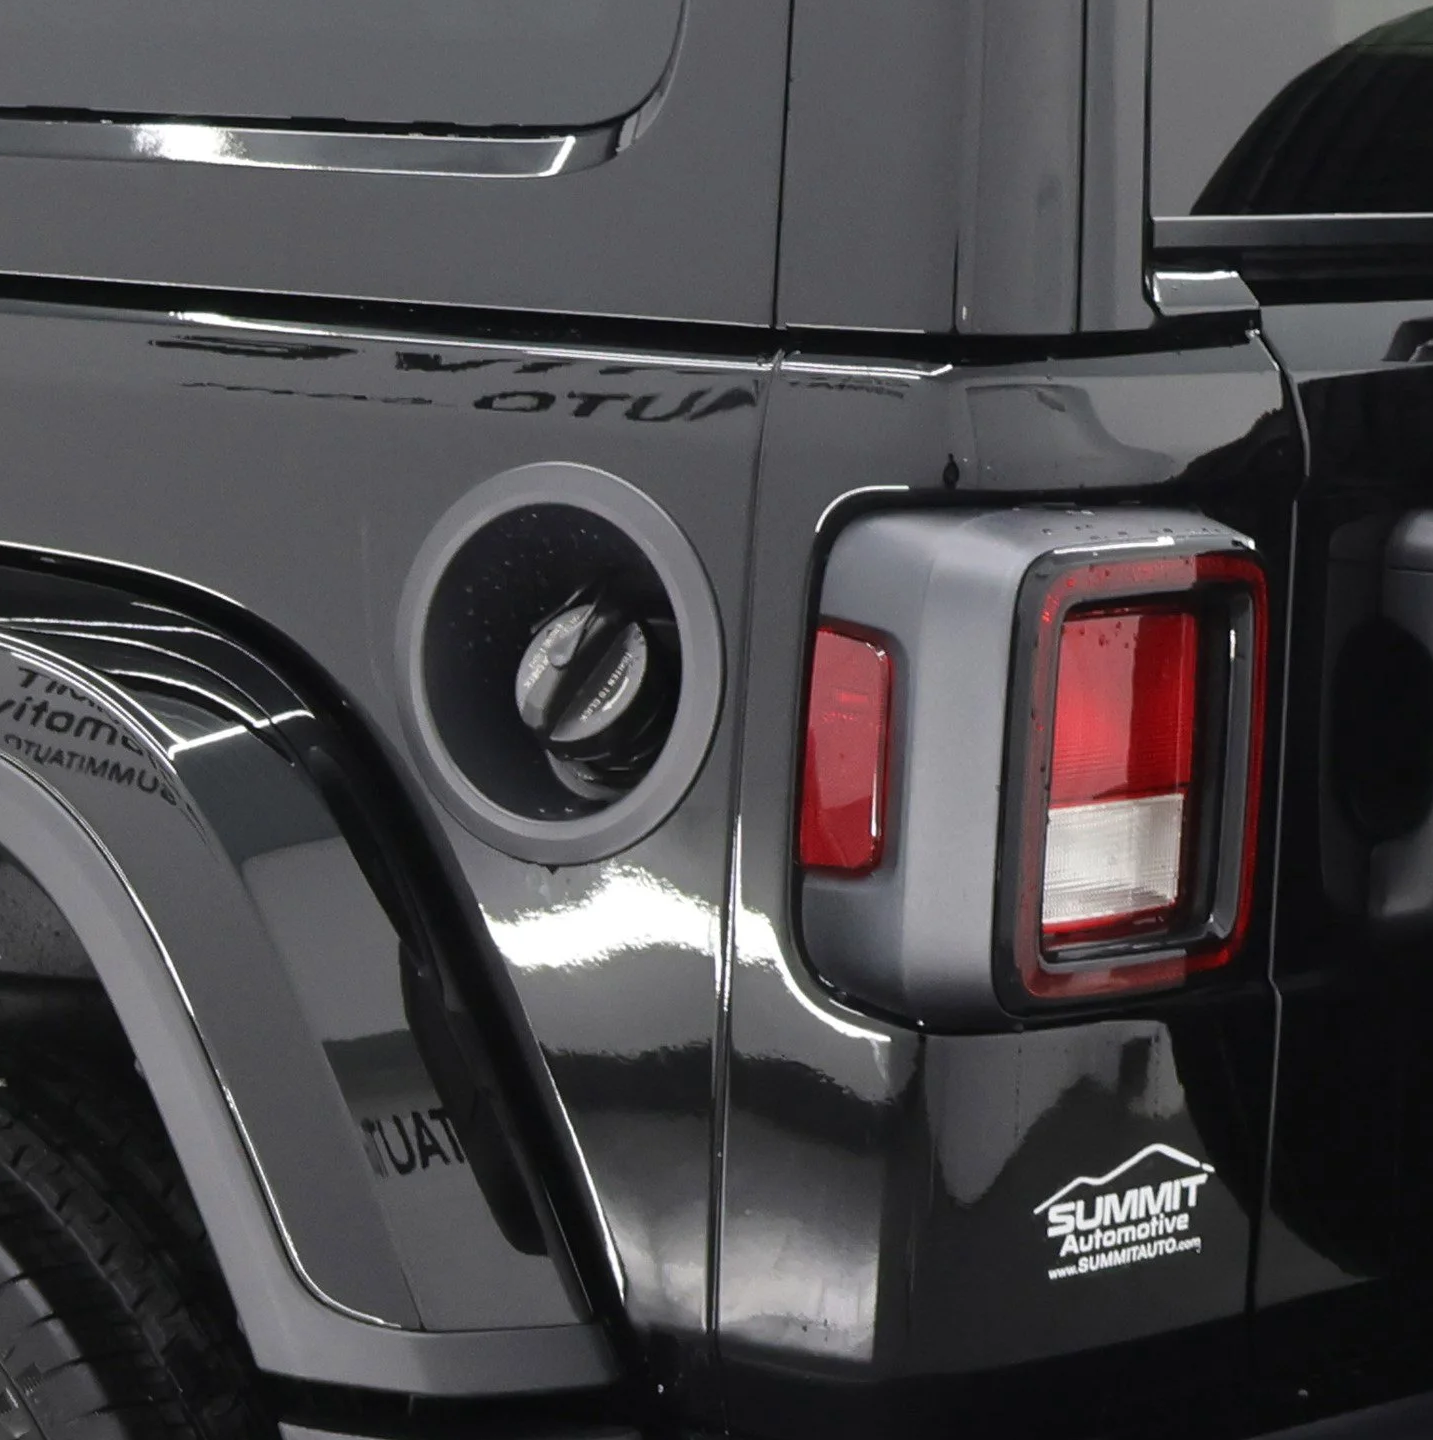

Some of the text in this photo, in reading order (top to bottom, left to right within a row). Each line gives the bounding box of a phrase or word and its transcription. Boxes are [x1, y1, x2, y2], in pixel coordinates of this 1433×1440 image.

[1047, 1173, 1208, 1238] SUMMIT
[1059, 1212, 1190, 1257] Automotive
[1047, 1236, 1202, 1280] www.SUMMITAUTO.com
